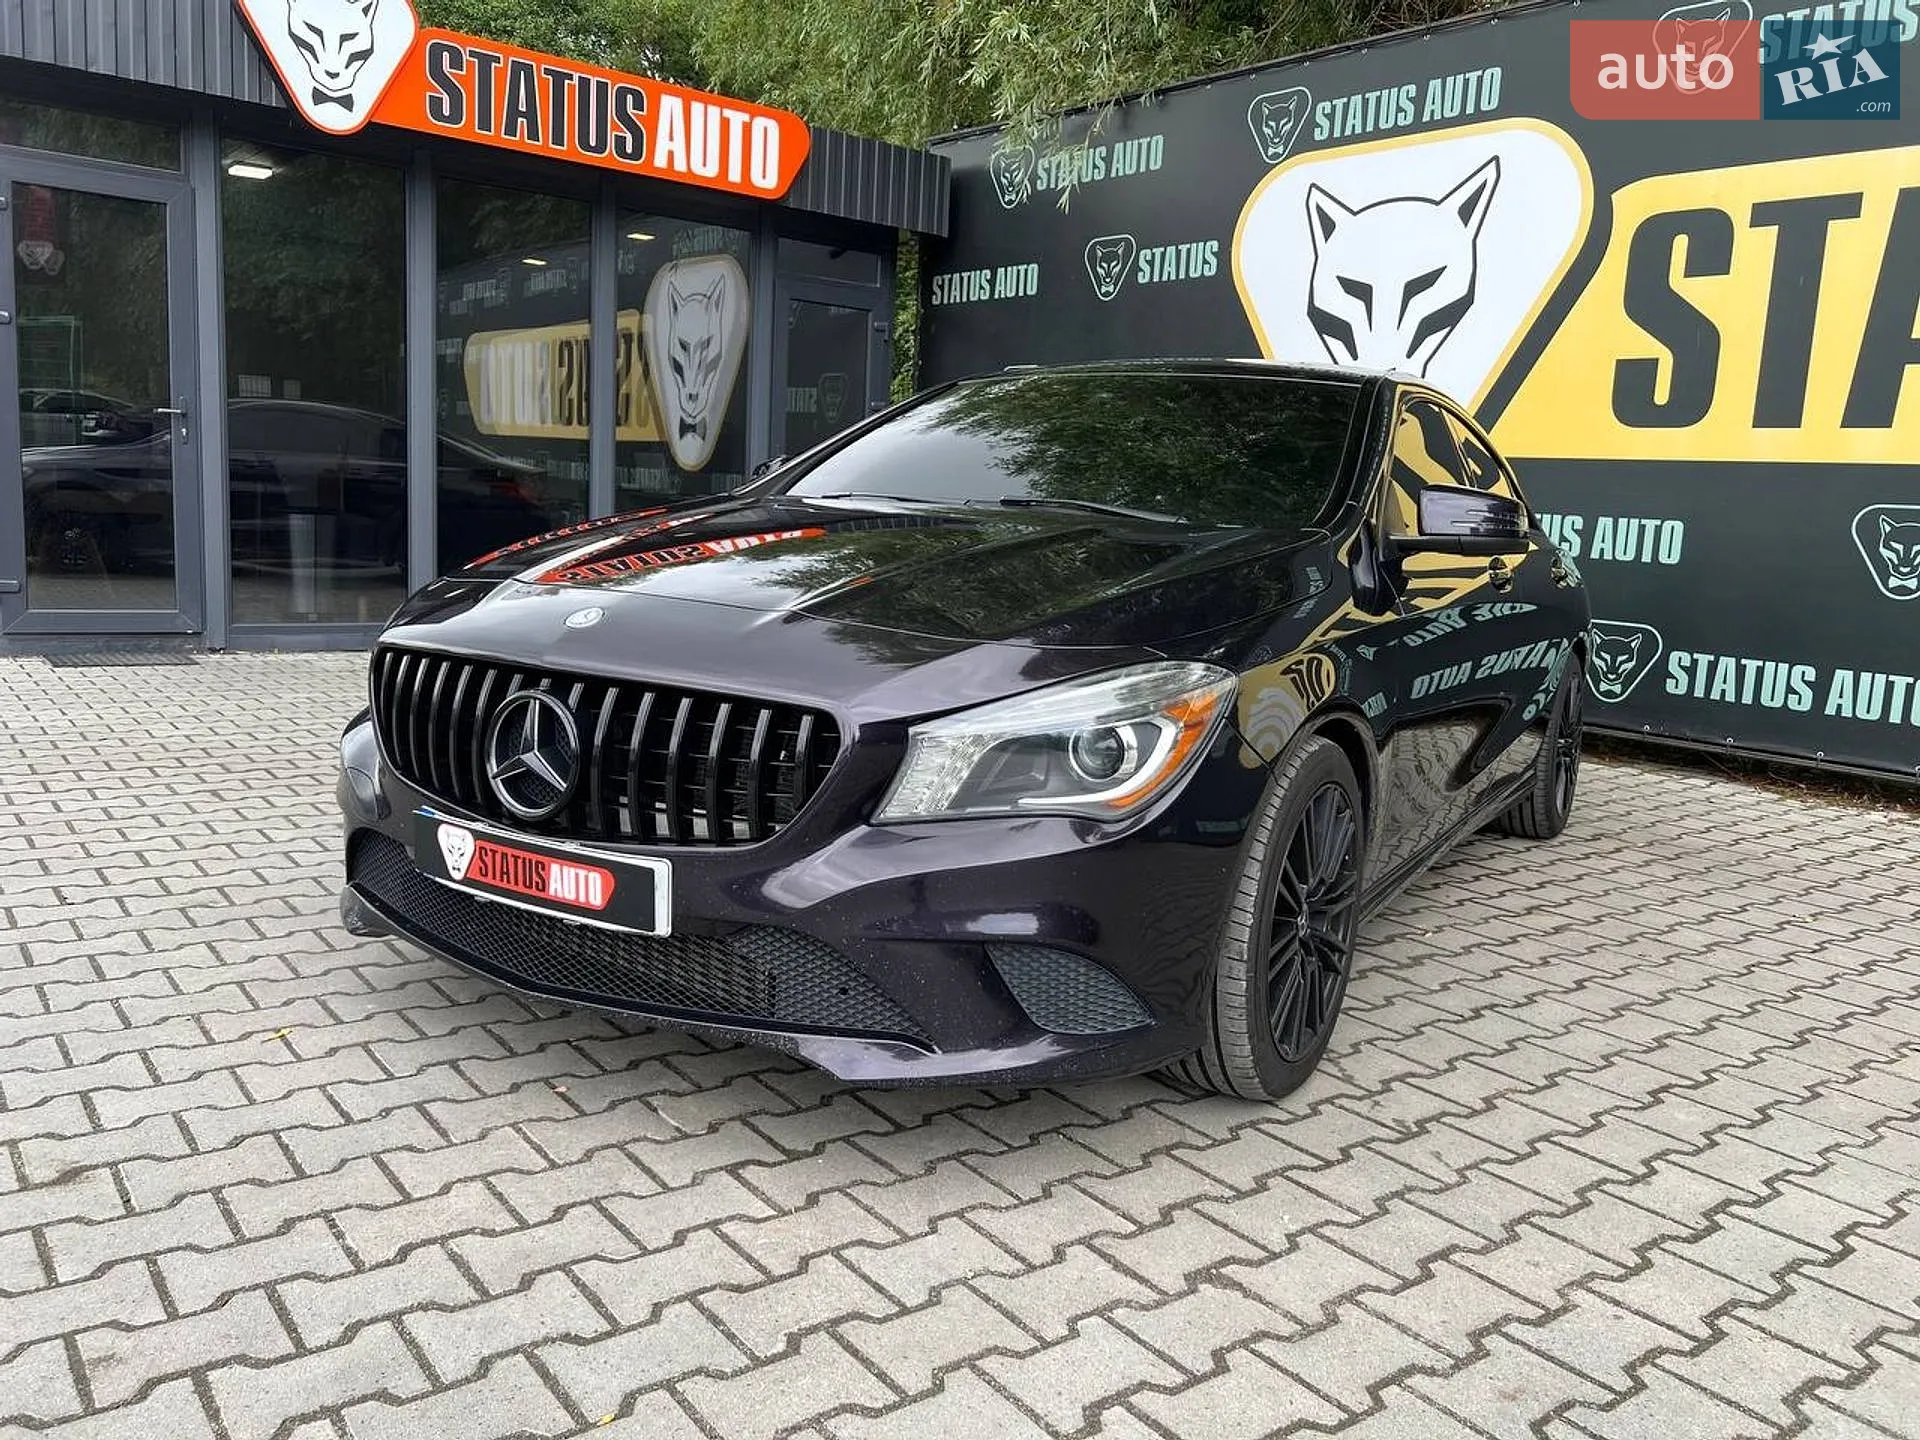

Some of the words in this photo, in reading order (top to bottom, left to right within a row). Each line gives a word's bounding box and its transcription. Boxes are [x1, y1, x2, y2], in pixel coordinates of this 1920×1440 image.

[424, 39, 648, 164] STATUS
[653, 93, 781, 190] AUTO
[1313, 83, 1416, 142] STATUS
[1422, 66, 1503, 122] AUTO
[1110, 134, 1164, 178] AUTO
[931, 266, 992, 305] STATUS
[994, 262, 1039, 300] AUTO
[1137, 240, 1219, 284] STATUS
[1534, 513, 1583, 557] US
[1590, 516, 1684, 564] AUTO
[1665, 650, 1817, 712] STATUS
[479, 846, 546, 893] STATUS
[549, 863, 601, 907] AUTO
